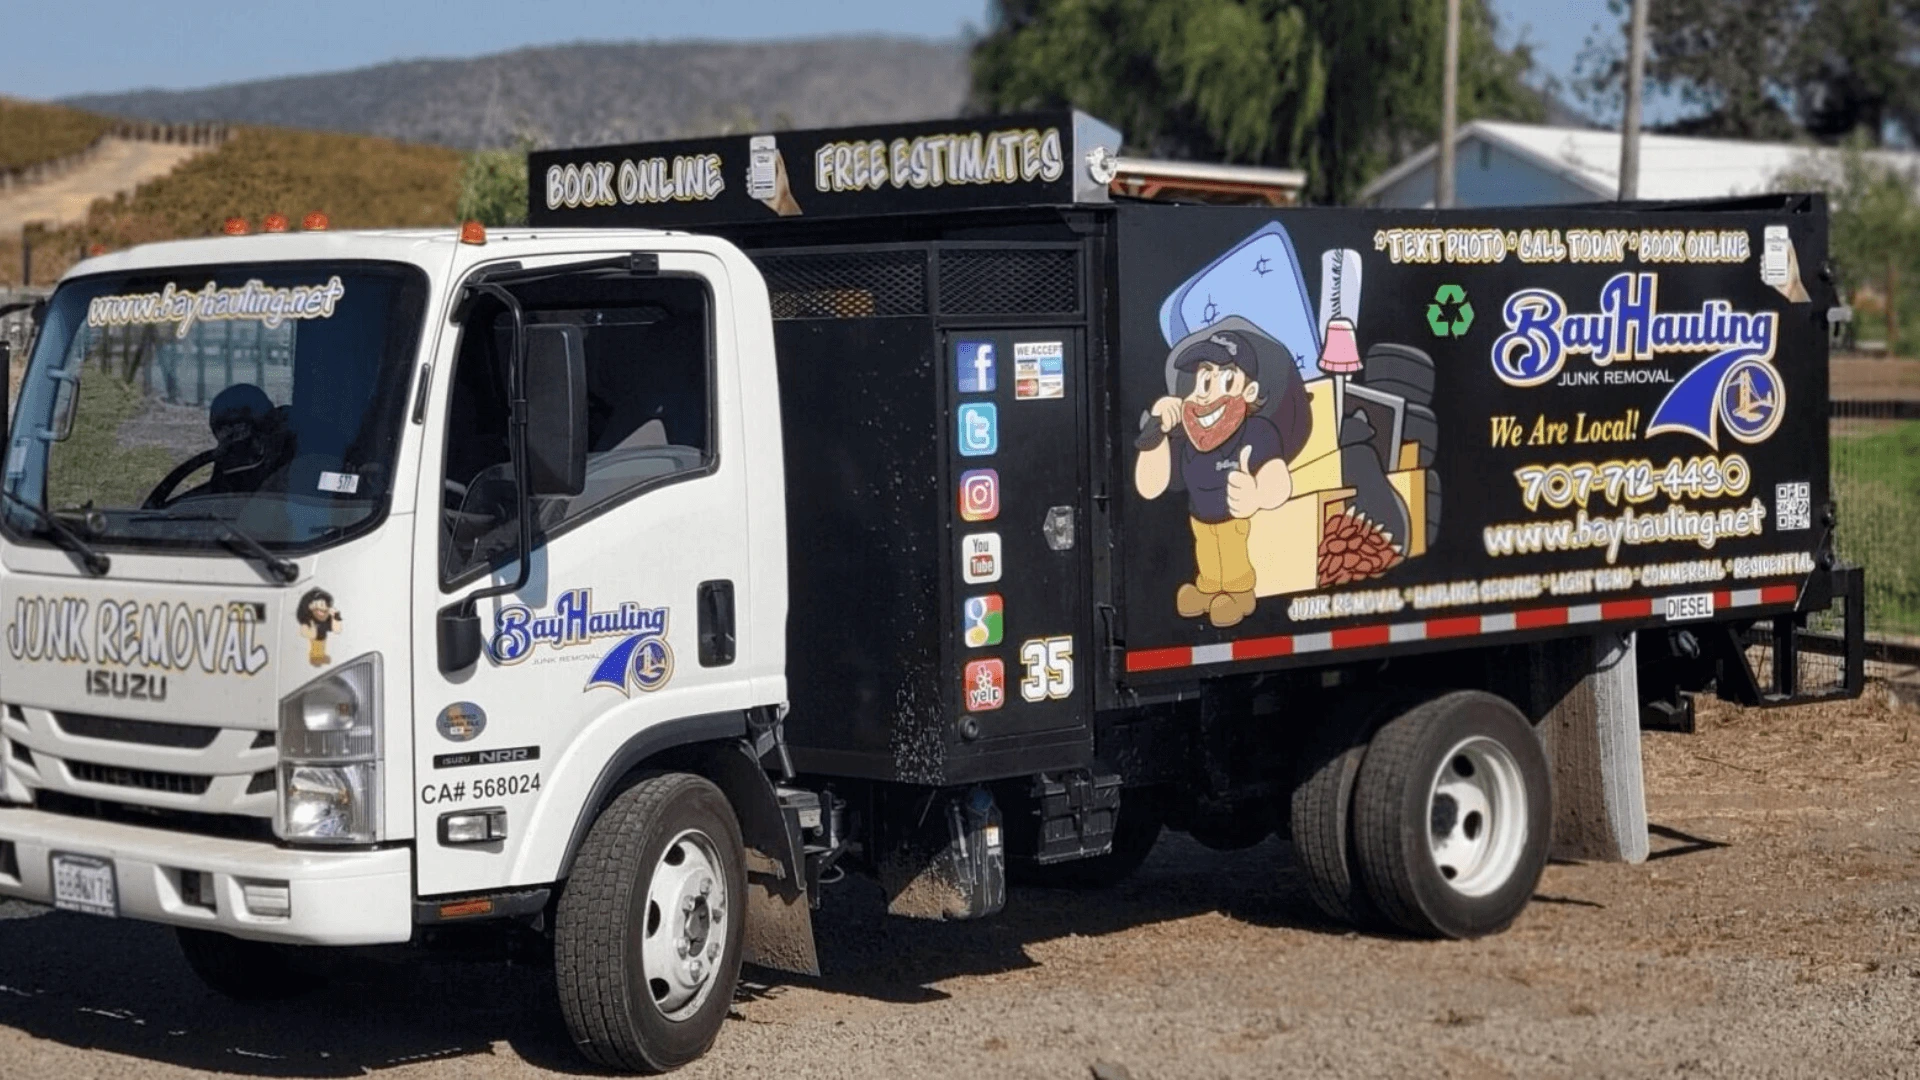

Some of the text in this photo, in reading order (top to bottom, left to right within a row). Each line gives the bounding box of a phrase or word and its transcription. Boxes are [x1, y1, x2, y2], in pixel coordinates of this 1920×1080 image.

[816, 128, 1063, 192] FREE ESTIMATES
[547, 153, 725, 210] BOOK ONLINE
[1387, 229, 1751, 263] TEXT PHOTO CALL TODAY BOOK ONLINE
[88, 276, 344, 338] www.bayhauling.net
[1017, 347, 1030, 356] WE
[1557, 369, 1675, 387] JUNK REMOVAL
[1490, 409, 1640, 448] We Are Local!
[1514, 454, 1750, 512] 707-712-4430
[972, 538, 988, 552] You
[1483, 497, 1766, 564] www.bayhauling.net
[972, 557, 993, 575] Tube
[1288, 595, 1331, 621] JUNK
[1331, 588, 1404, 617] REMOVAL
[1641, 560, 1725, 587] COMMERCIAL
[1732, 552, 1816, 578] RESIDENTIAL
[1667, 597, 1712, 618] DIESEL
[7, 596, 268, 675] JUNK REMOVAL
[86, 670, 167, 701] ISUZU
[1020, 635, 1075, 702] 35
[971, 687, 1000, 707] yelp
[442, 748, 528, 765] ISUZU NRR
[421, 772, 541, 805] CA# 568024
